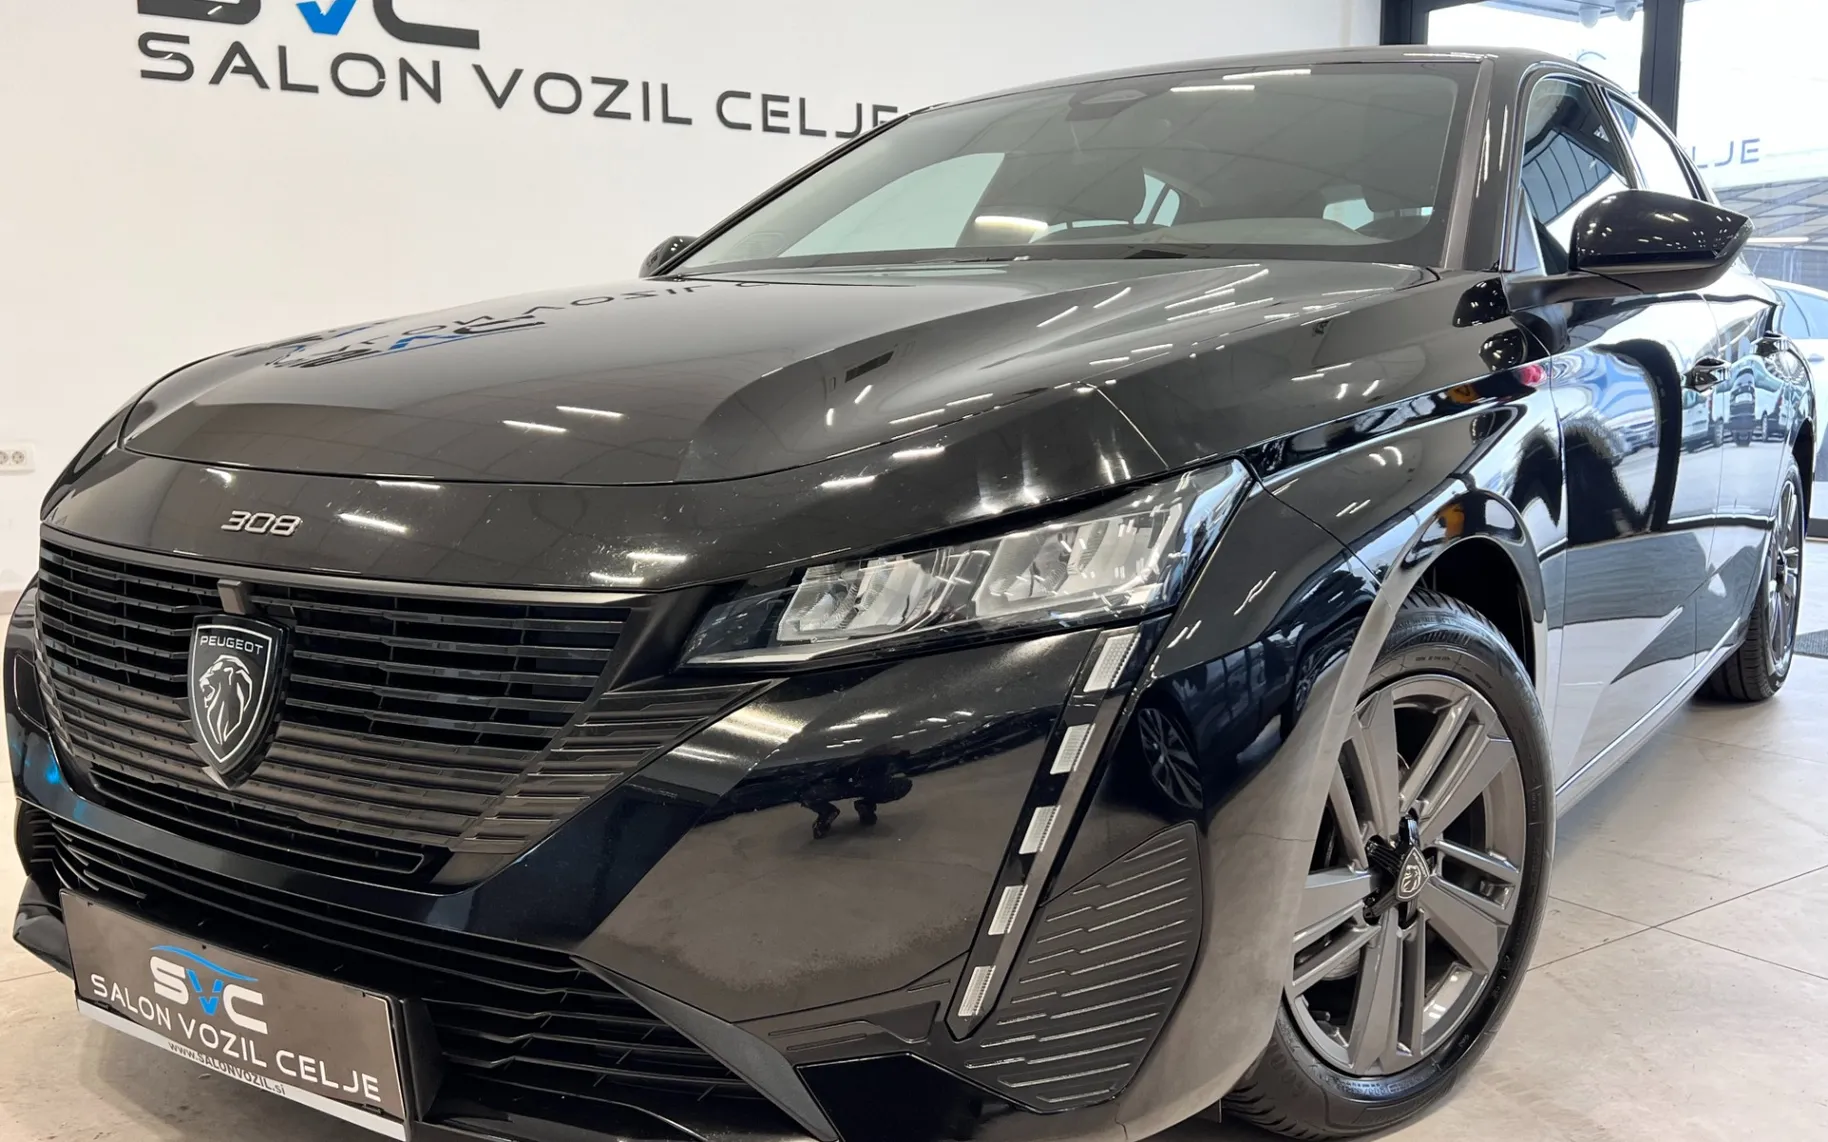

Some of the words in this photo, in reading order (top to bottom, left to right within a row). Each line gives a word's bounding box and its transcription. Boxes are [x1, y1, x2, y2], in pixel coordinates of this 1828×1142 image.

[138, 31, 442, 104] SALON
[472, 63, 693, 125] VOZIL
[221, 510, 302, 536] 308
[200, 635, 264, 655] PEUGEOT
[150, 955, 268, 1035] SVC
[90, 973, 171, 1031] SALON
[178, 1012, 267, 1068] VOZIL
[276, 1049, 381, 1102] CELJE
